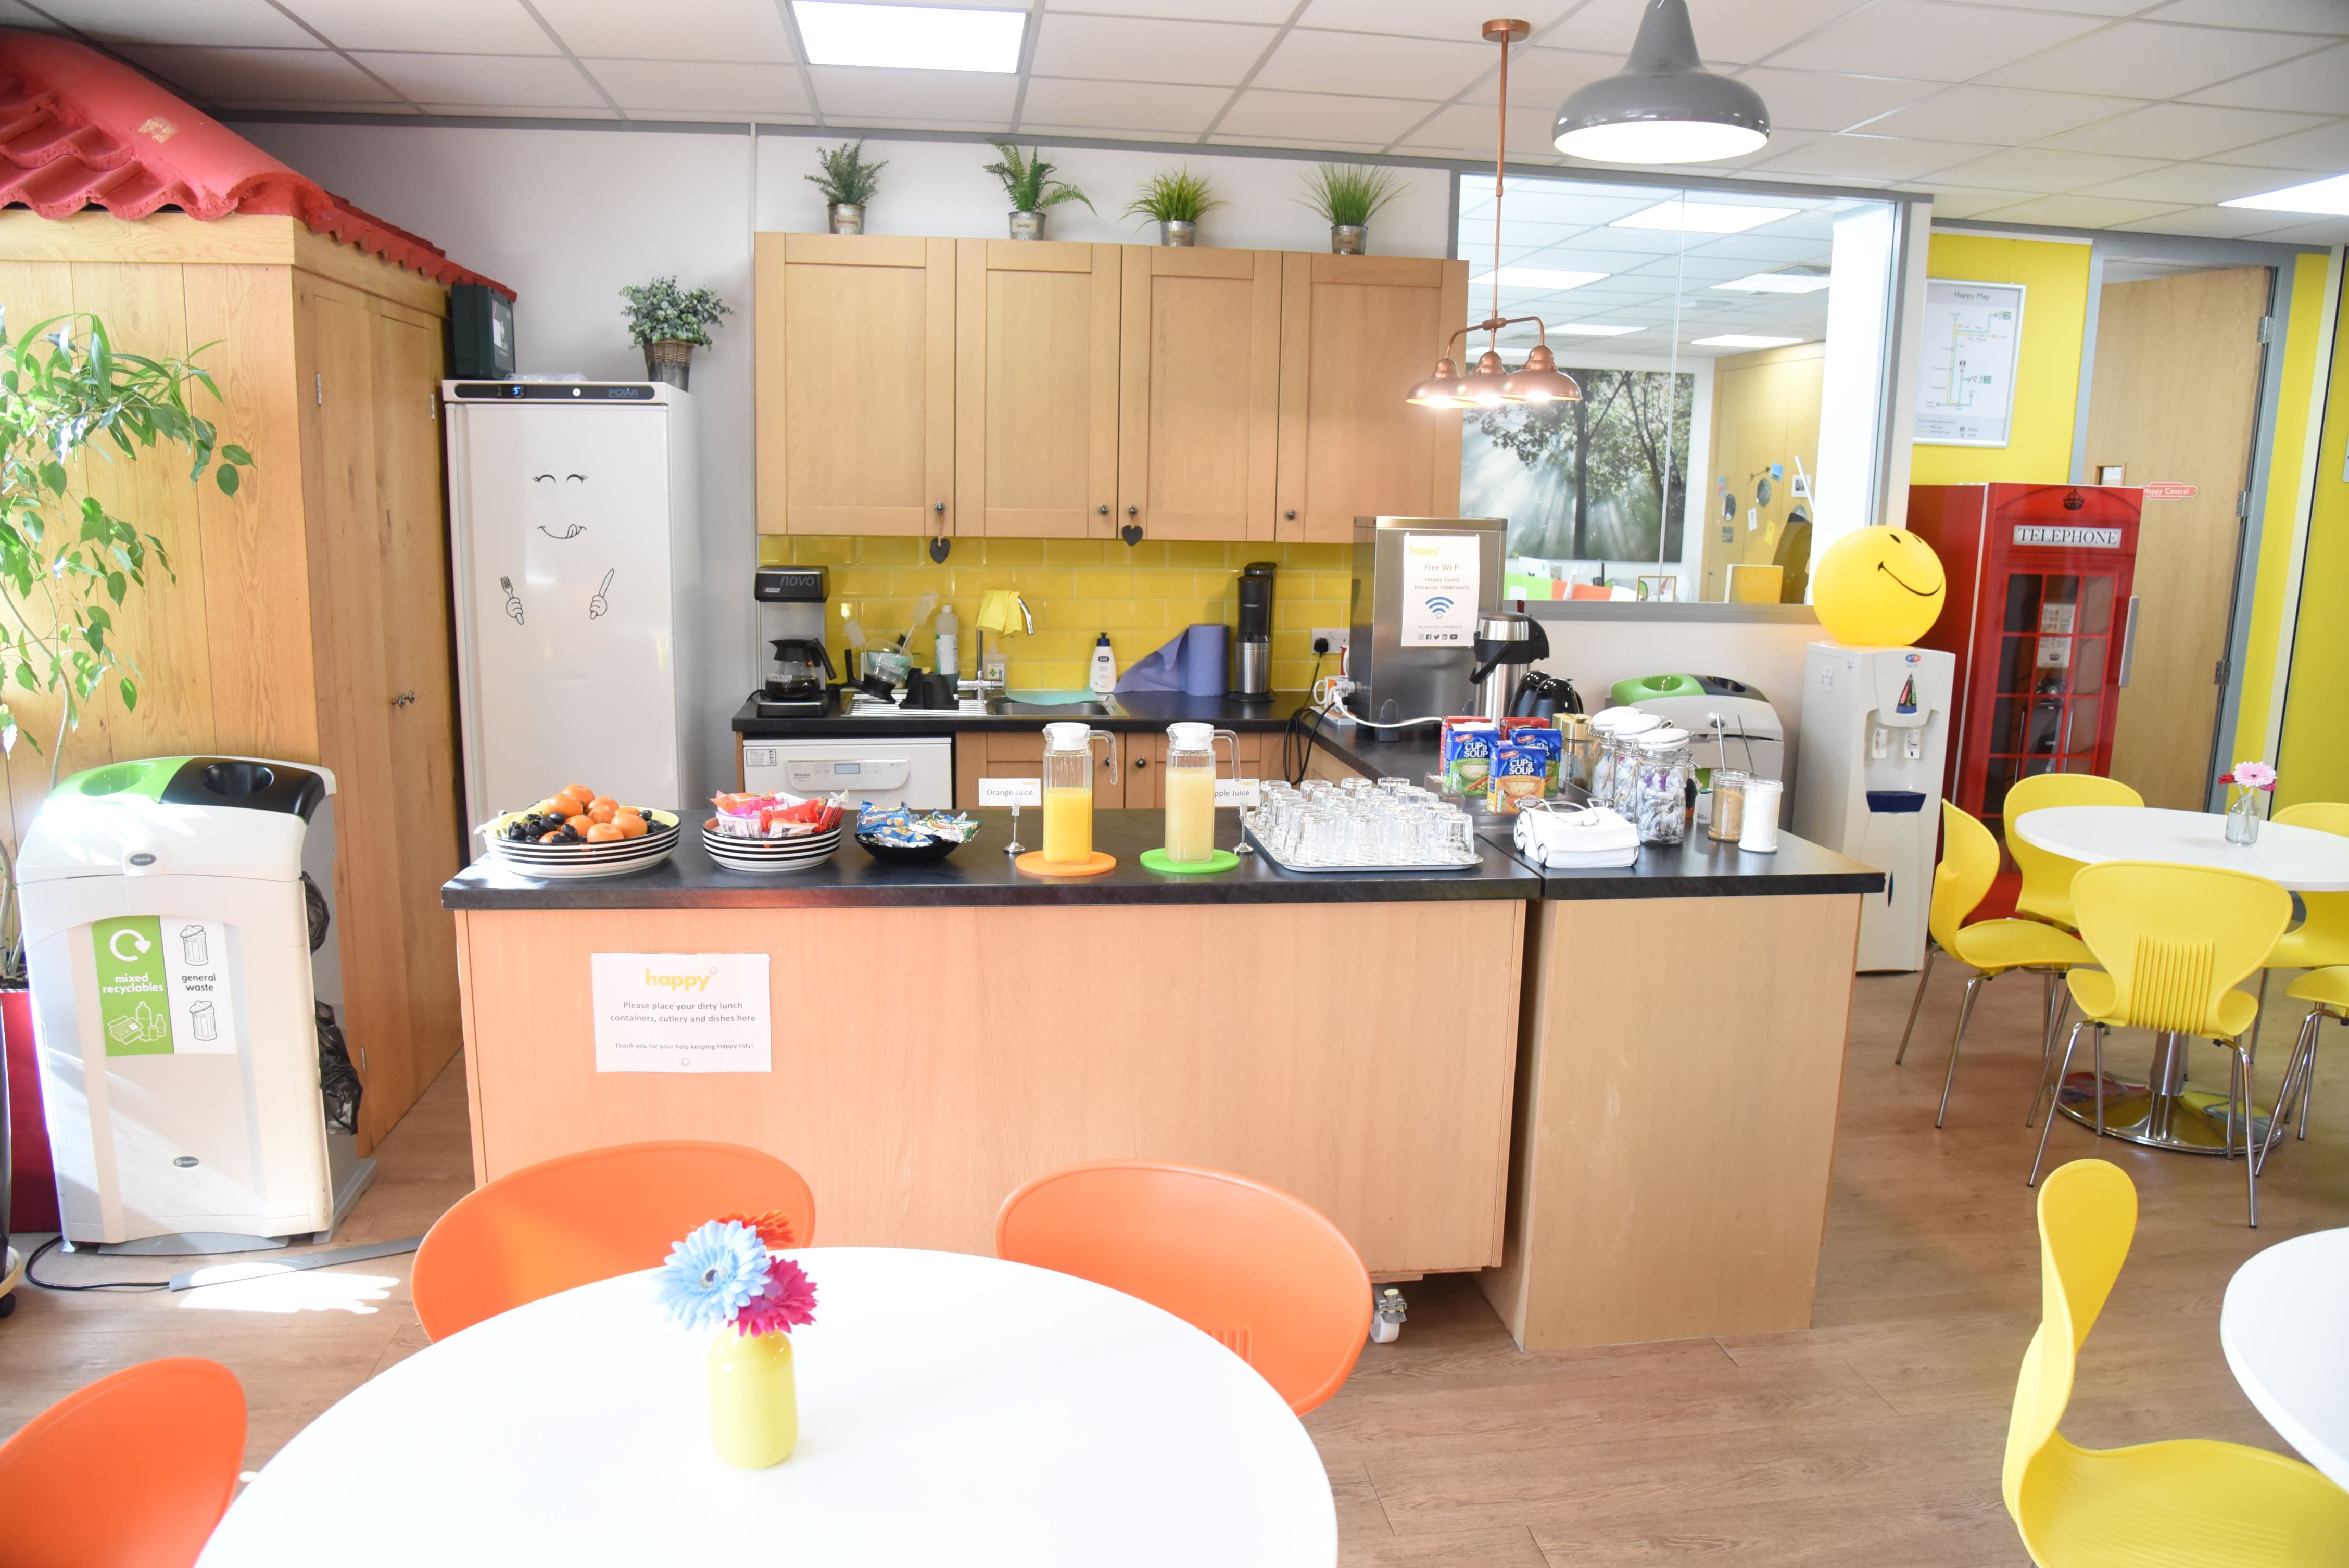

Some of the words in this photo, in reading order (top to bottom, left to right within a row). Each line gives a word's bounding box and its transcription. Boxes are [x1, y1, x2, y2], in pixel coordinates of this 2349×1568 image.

[1954, 291, 1974, 301] Happy
[1976, 293, 1990, 301] Map
[2018, 528, 2117, 545] TELEPHONE
[1409, 546, 1439, 557] happy
[780, 576, 815, 586] novo
[1214, 790, 1230, 798] pple
[115, 972, 149, 983] mixed
[181, 973, 216, 983] general
[645, 968, 710, 991] happy
[102, 982, 164, 995] recyclables
[652, 1002, 674, 1010] place
[698, 1002, 717, 1010] dirty
[610, 1014, 657, 1023] containers,
[659, 1015, 687, 1023] cutlery
